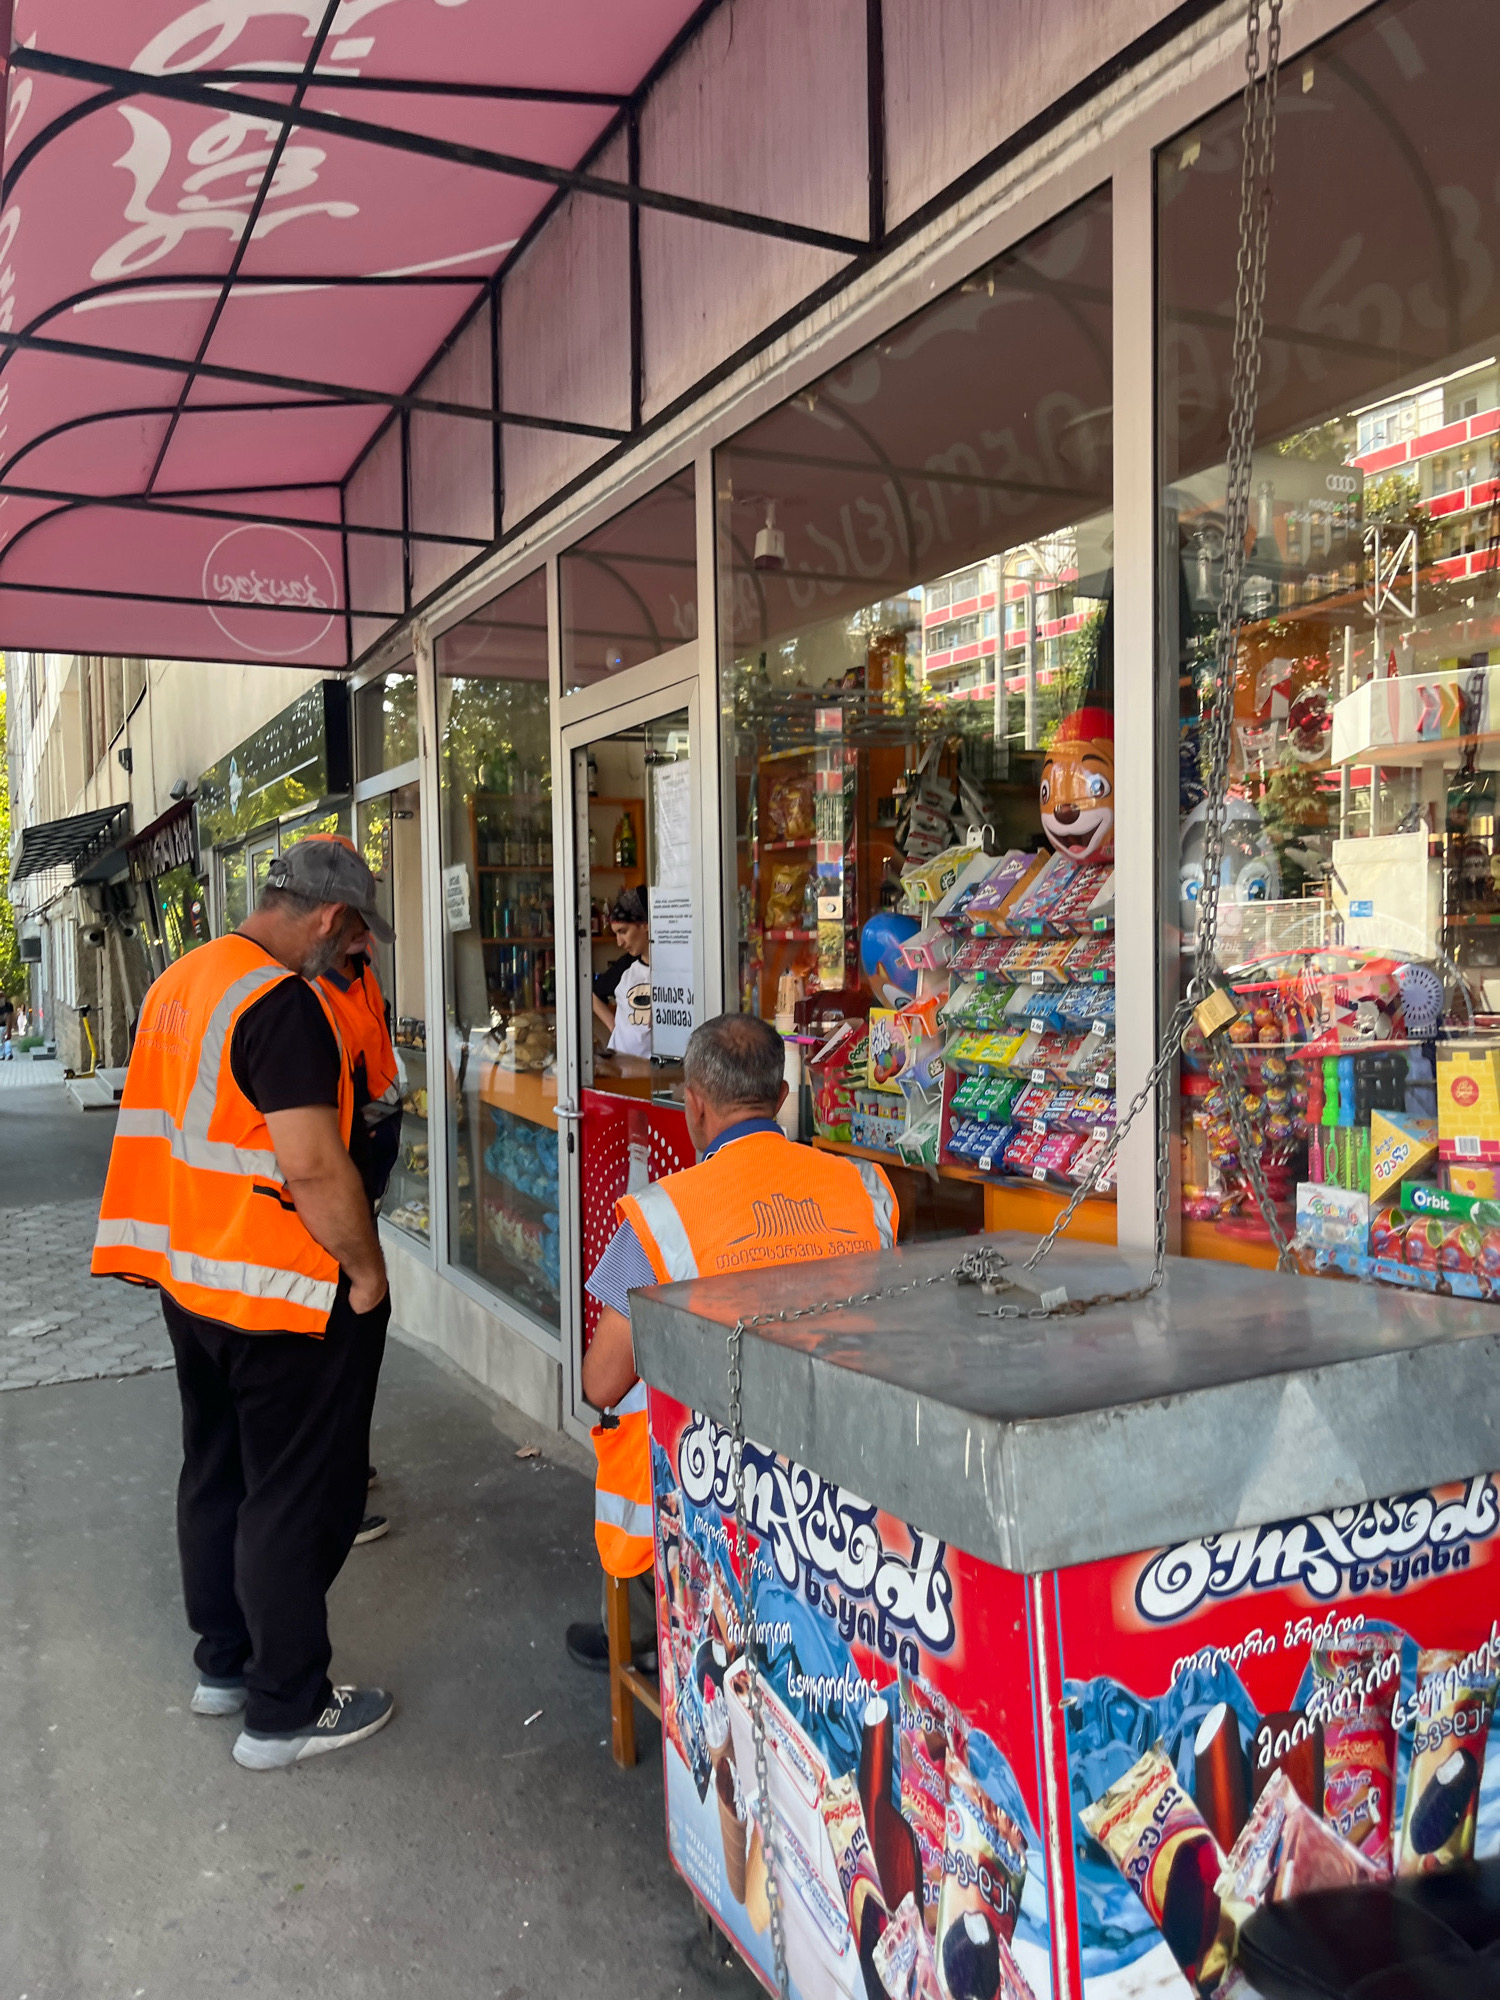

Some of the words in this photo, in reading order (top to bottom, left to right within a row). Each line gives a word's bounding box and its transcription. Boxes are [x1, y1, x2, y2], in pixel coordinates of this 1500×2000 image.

[656, 1008, 692, 1027] გაიცემა
[1411, 1187, 1450, 1211] Orbit
[716, 1242, 823, 1270] თბილსერვის
[1348, 1542, 1471, 1594] ნაყინი
[804, 1567, 920, 1677] ნაყინი
[1171, 1628, 1277, 1687] ლიდერი
[1283, 1610, 1365, 1649] ბრენდი
[1257, 1652, 1400, 1769] მიირთვით
